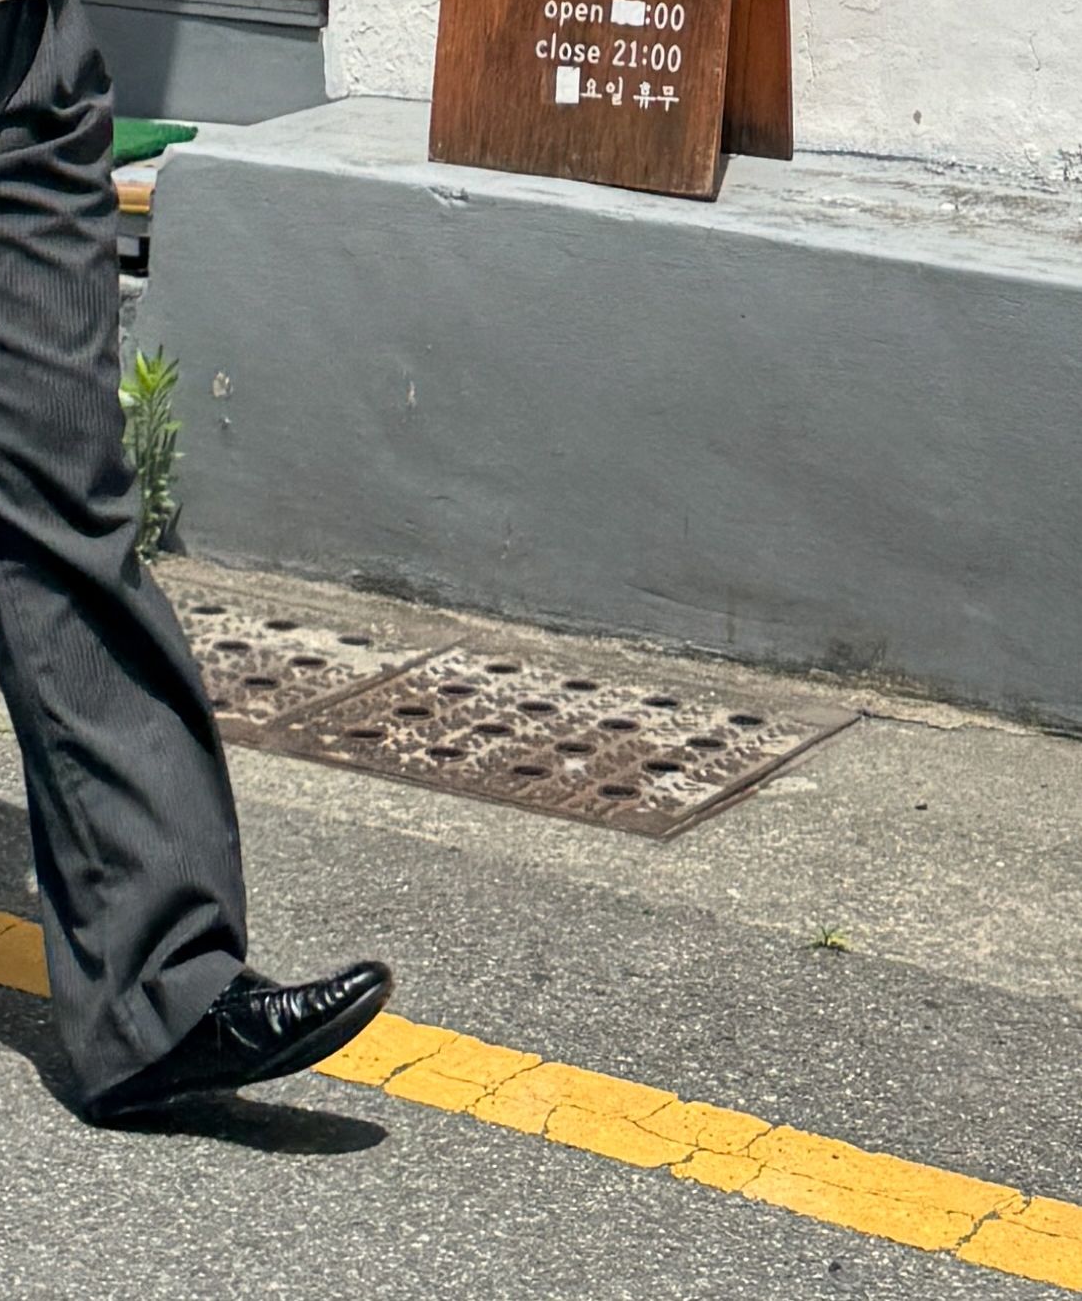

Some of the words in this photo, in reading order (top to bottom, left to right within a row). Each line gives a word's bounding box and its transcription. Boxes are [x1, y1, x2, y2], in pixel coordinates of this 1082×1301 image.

[544, 0, 604, 27] open
[535, 32, 601, 64] close
[612, 39, 682, 73] 21:00
[555, 66, 624, 106] 요일
[633, 81, 680, 112] 휴무
